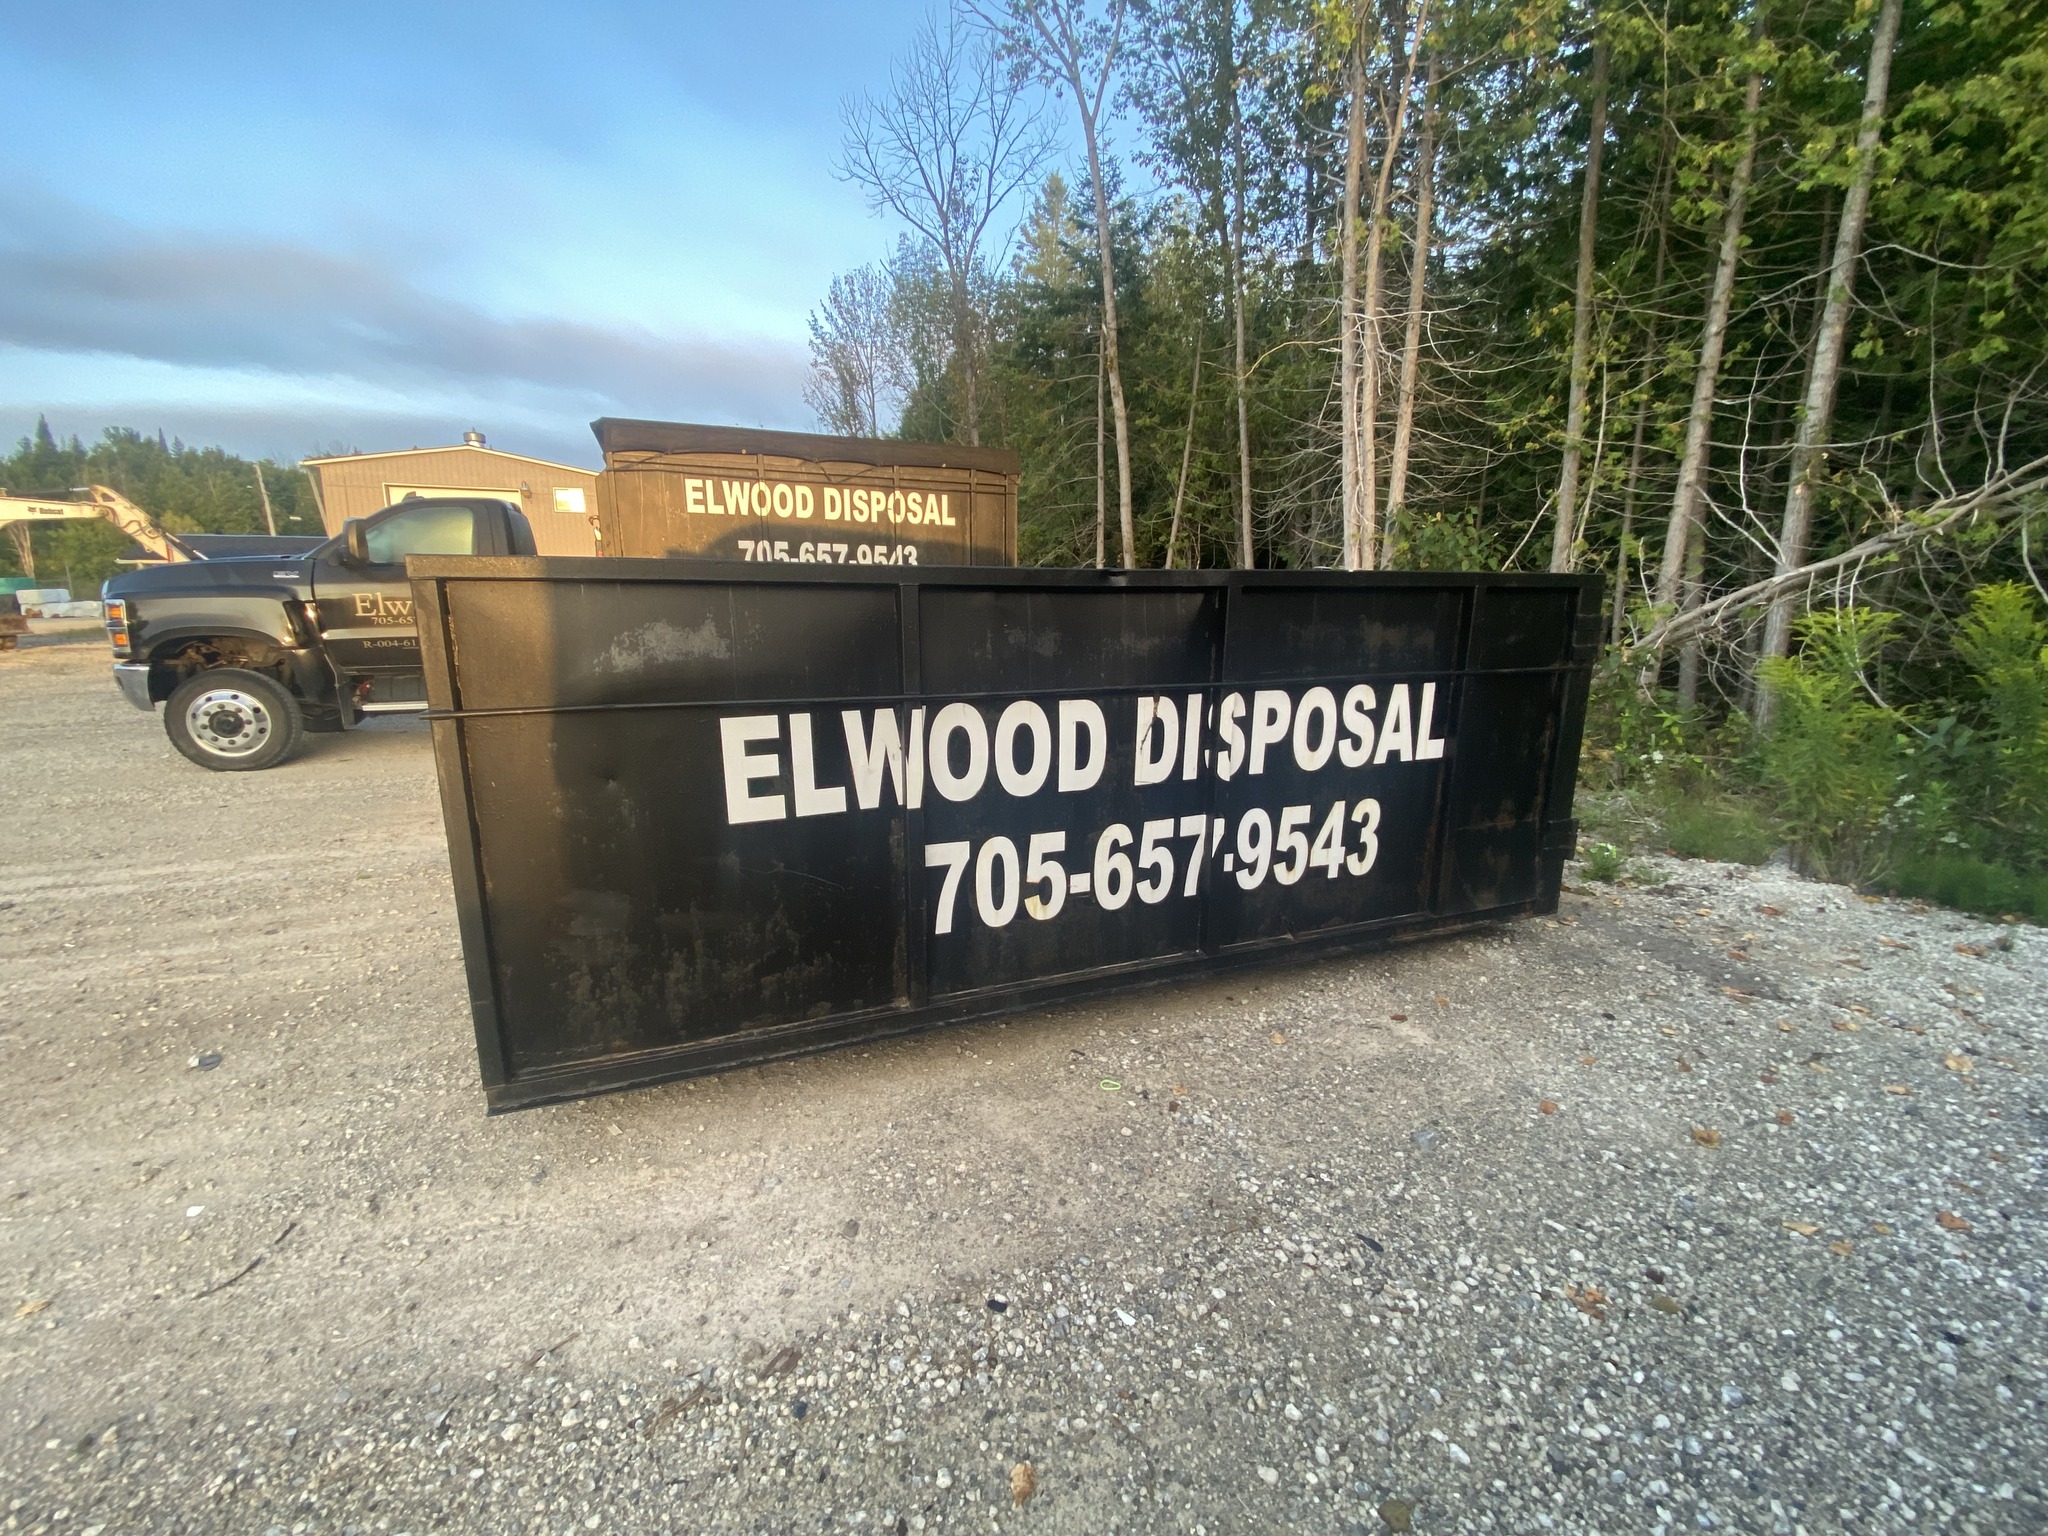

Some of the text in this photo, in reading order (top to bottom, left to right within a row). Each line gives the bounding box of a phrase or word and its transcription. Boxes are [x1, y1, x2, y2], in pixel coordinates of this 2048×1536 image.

[685, 479, 956, 526] ELWOOD DISPOSAL
[352, 592, 412, 616] Elw
[371, 617, 415, 625] 705-65
[363, 640, 418, 649] R-004-61
[720, 682, 1445, 824] ELWOOD DISPOSAL
[925, 798, 1380, 935] 705-657-9543
